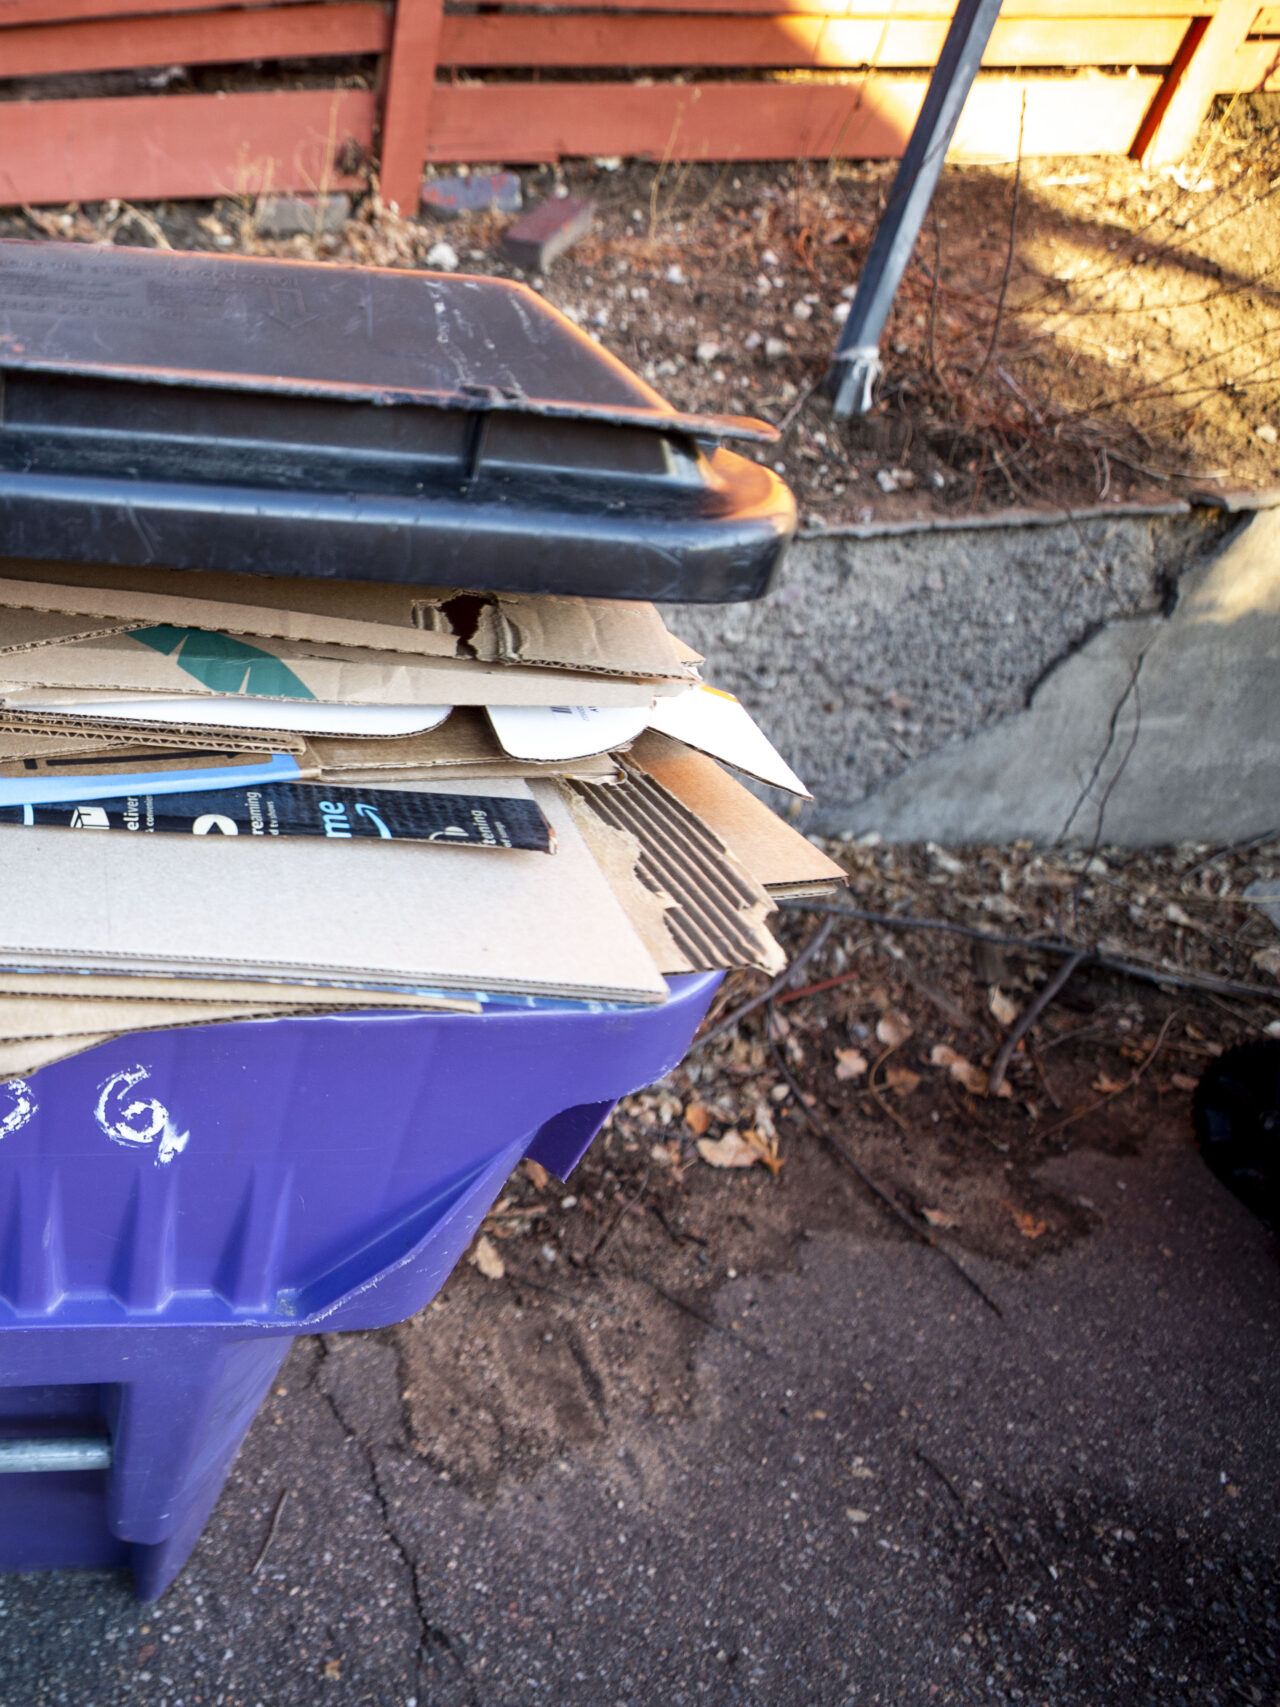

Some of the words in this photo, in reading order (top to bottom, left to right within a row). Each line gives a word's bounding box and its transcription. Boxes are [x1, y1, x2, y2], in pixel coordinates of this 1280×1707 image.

[123, 796, 140, 831] eliver
[244, 791, 264, 835] reaming
[319, 801, 352, 838] me
[470, 809, 496, 845] tening
